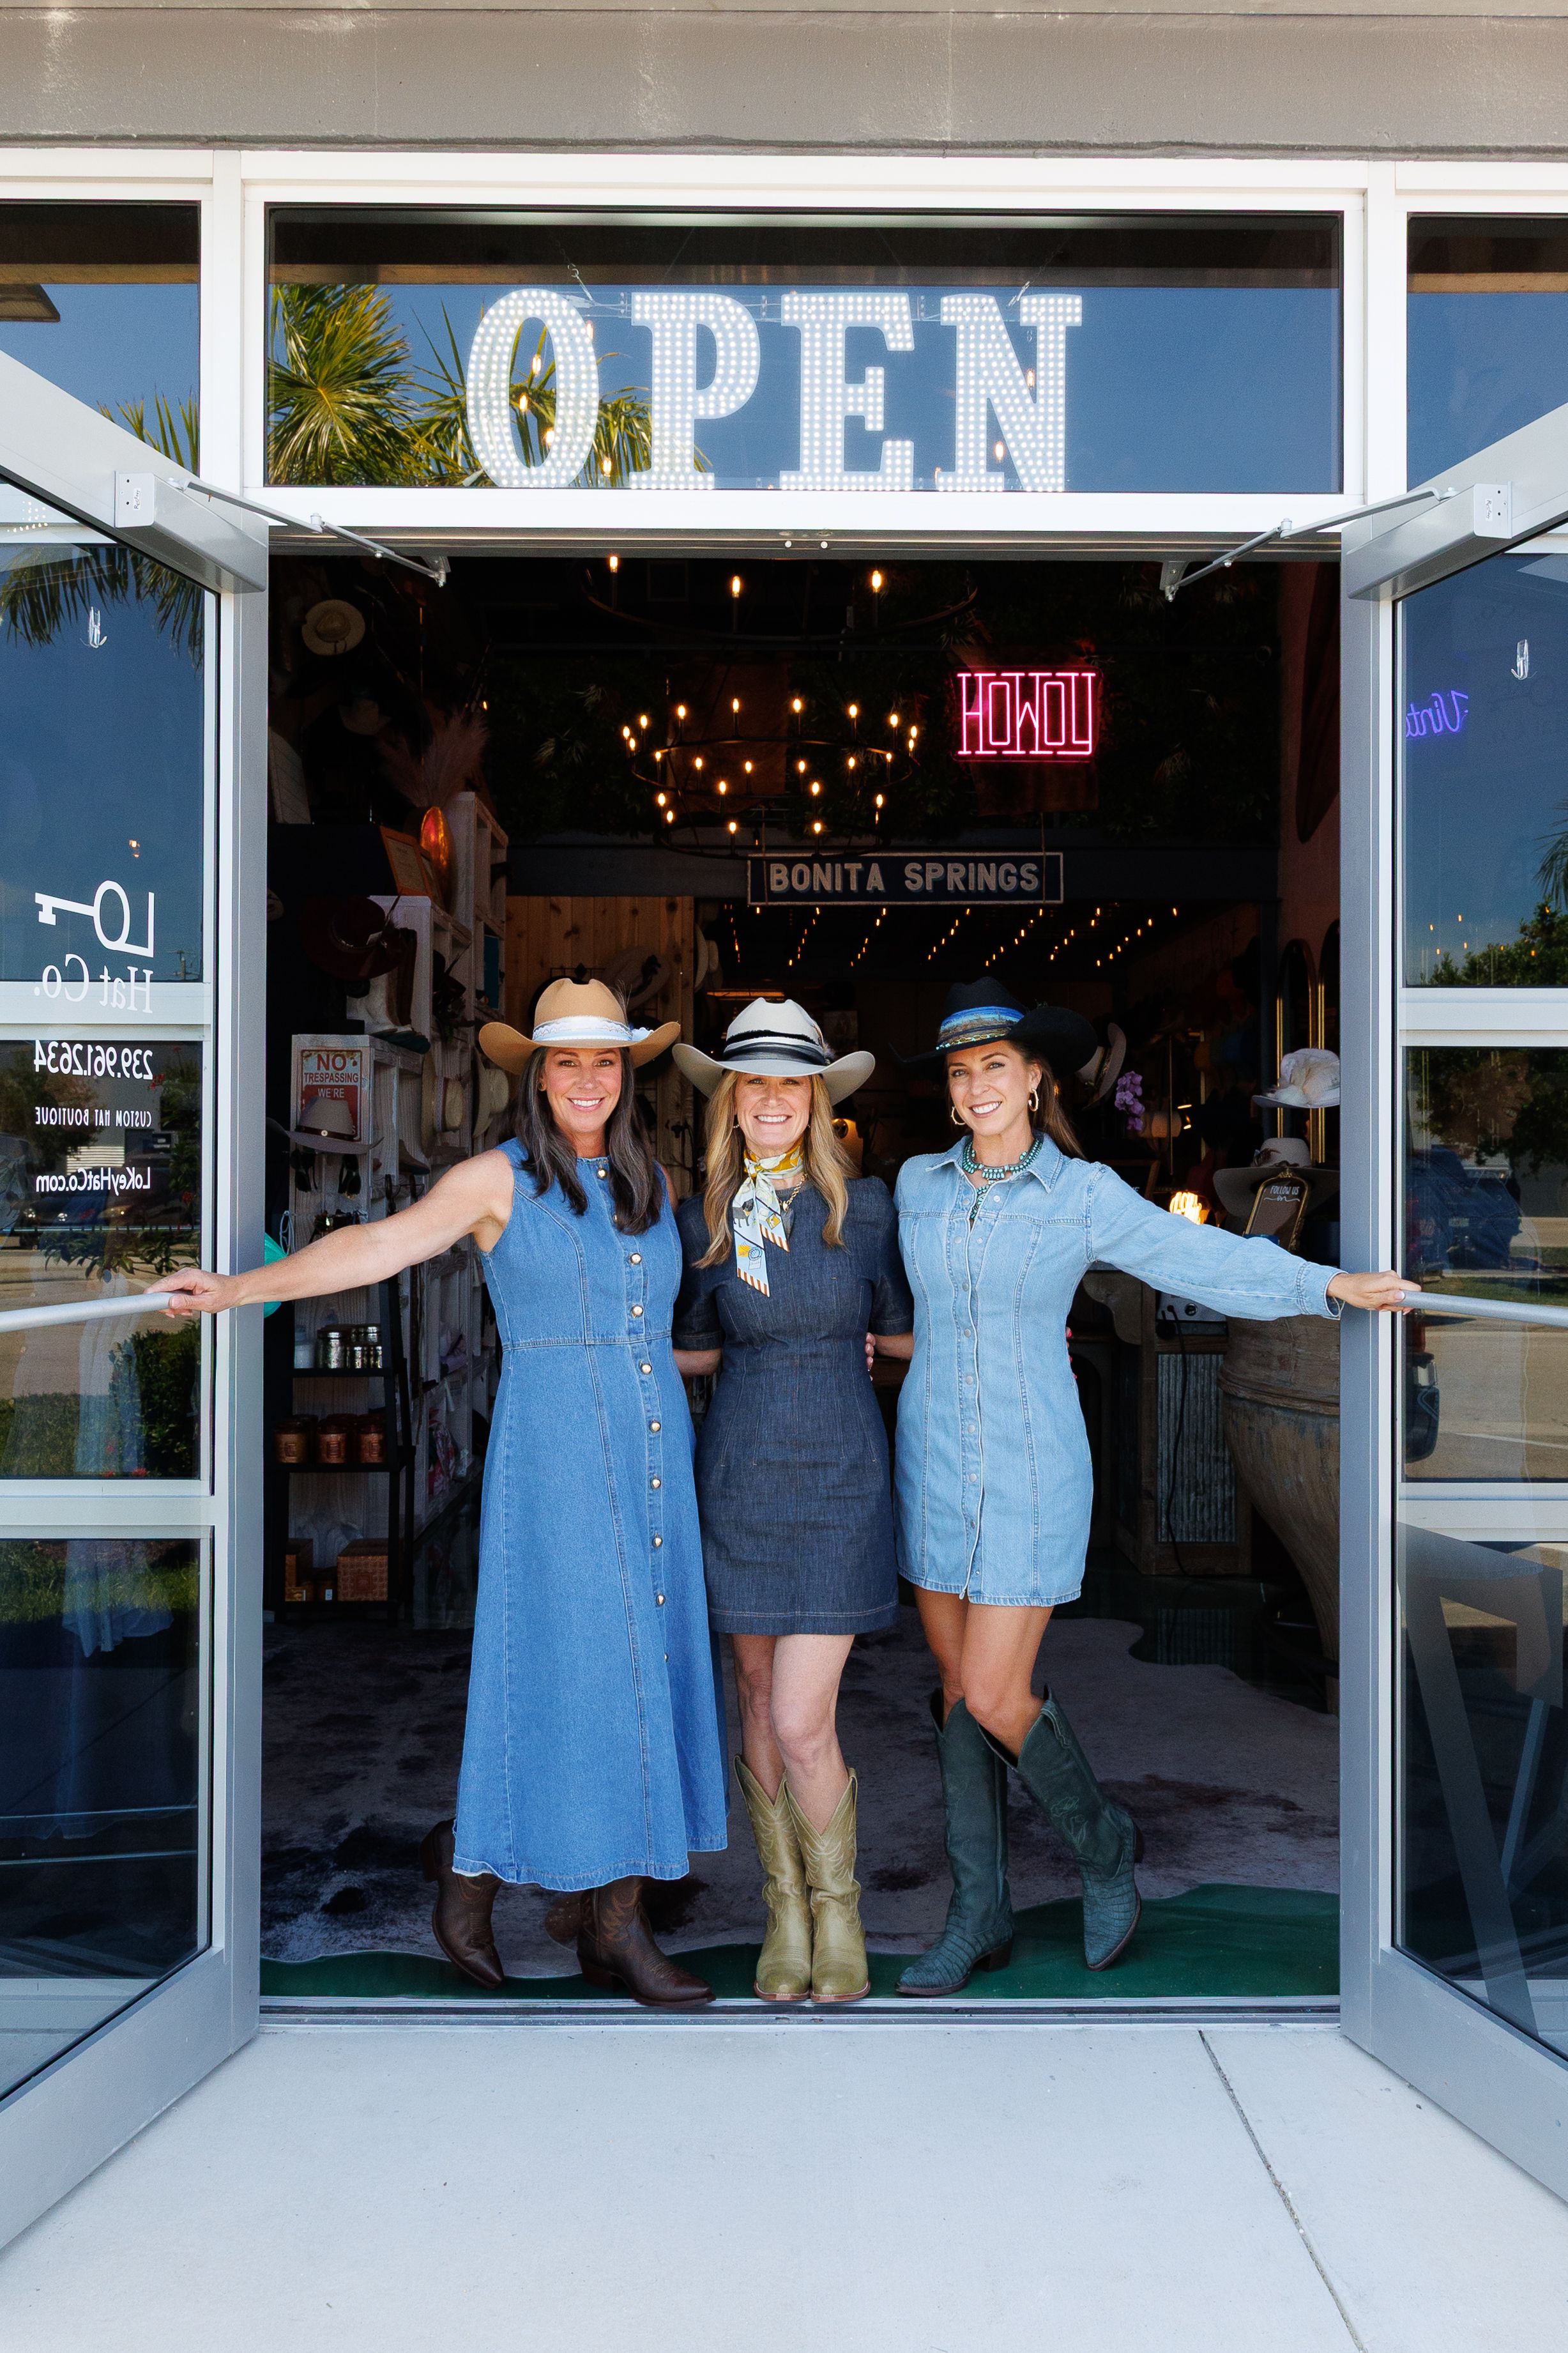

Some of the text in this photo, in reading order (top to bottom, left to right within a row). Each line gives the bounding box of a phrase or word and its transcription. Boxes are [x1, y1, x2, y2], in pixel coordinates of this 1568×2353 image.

[466, 288, 1082, 491] OPEN
[770, 862, 1040, 893] BONITA SPRINGS
[317, 1054, 347, 1071] NO
[304, 1073, 358, 1083] TRESPASSING
[318, 1088, 345, 1098] WE'RE
[1270, 1186, 1290, 1194] FOLLOW
